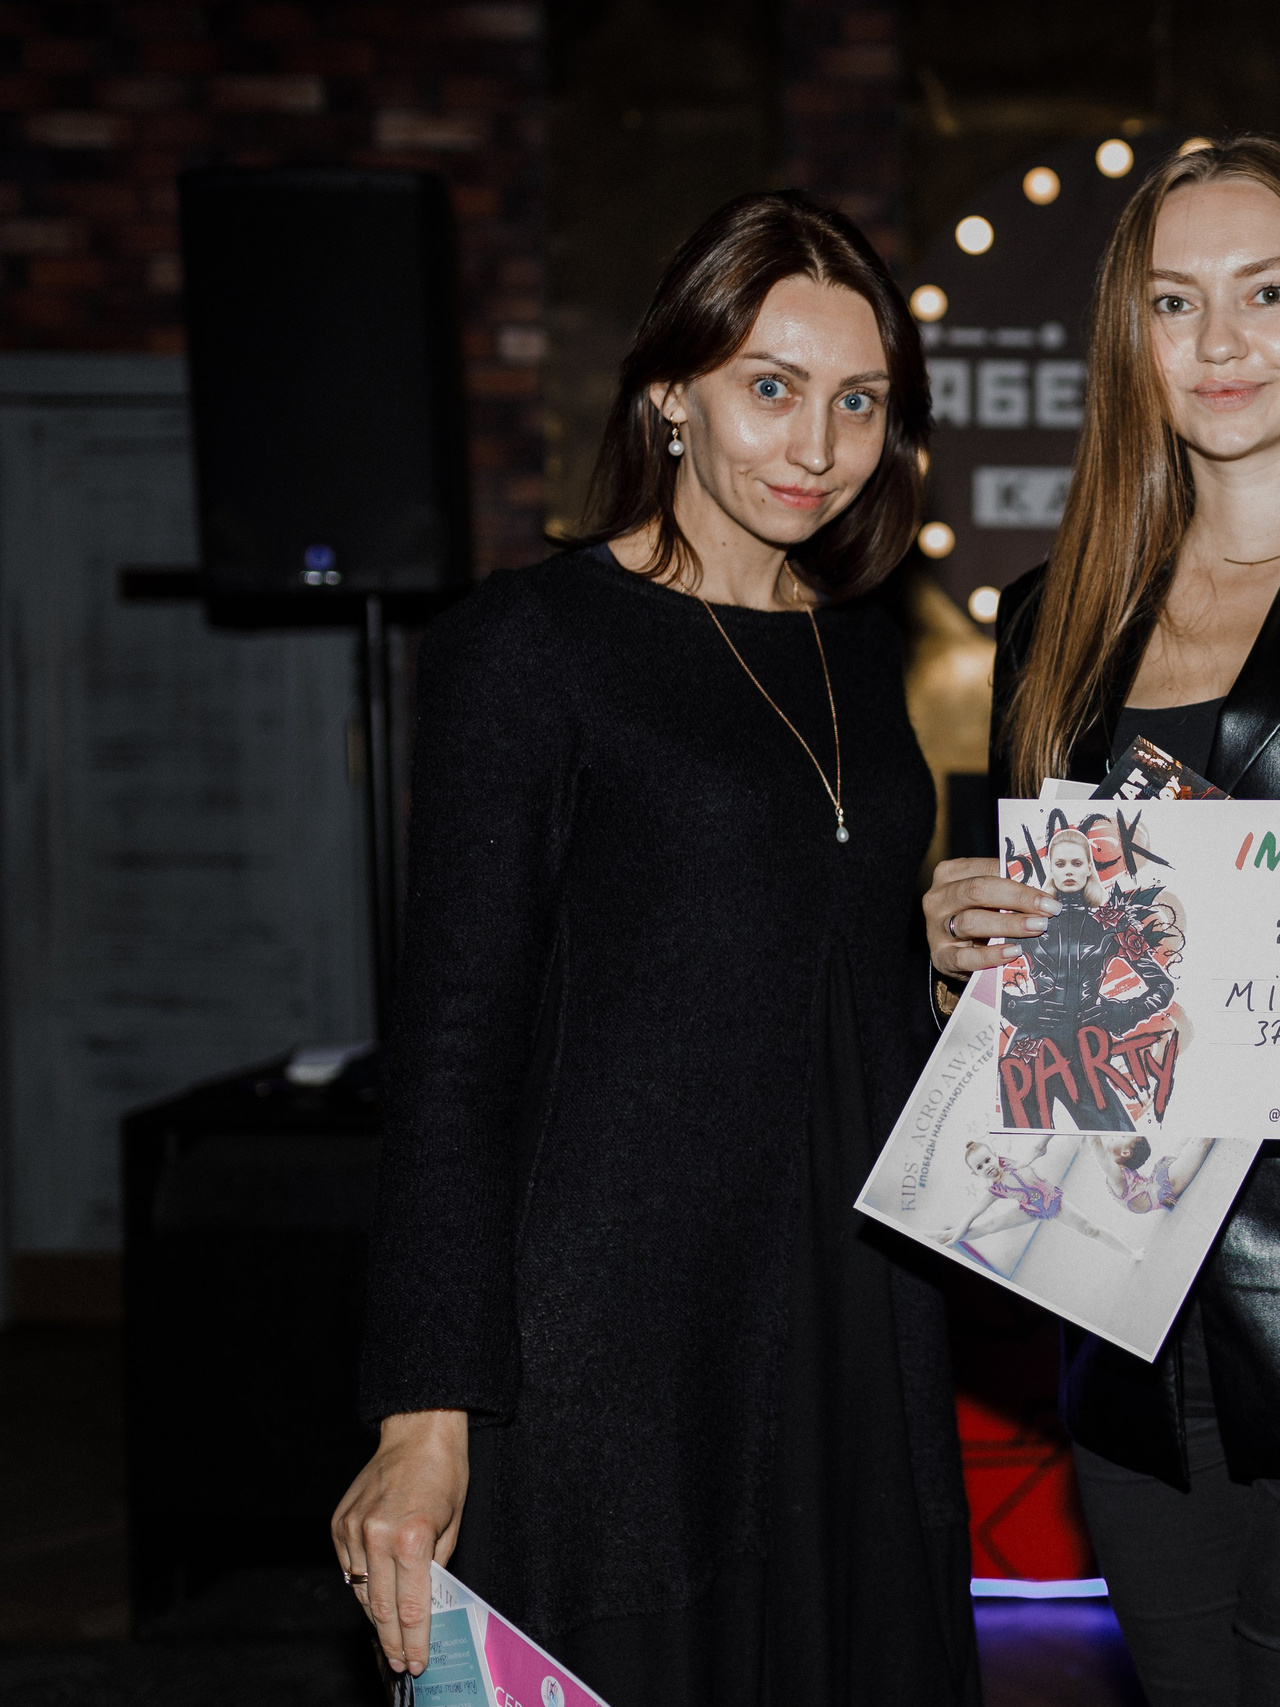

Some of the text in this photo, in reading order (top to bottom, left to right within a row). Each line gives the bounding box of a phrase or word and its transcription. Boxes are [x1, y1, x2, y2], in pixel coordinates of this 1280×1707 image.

[932, 1071, 974, 1139] НАЧИНАЮТСЯ
[1000, 1026, 1180, 1130] PARTY
[911, 1089, 943, 1147] ACRO
